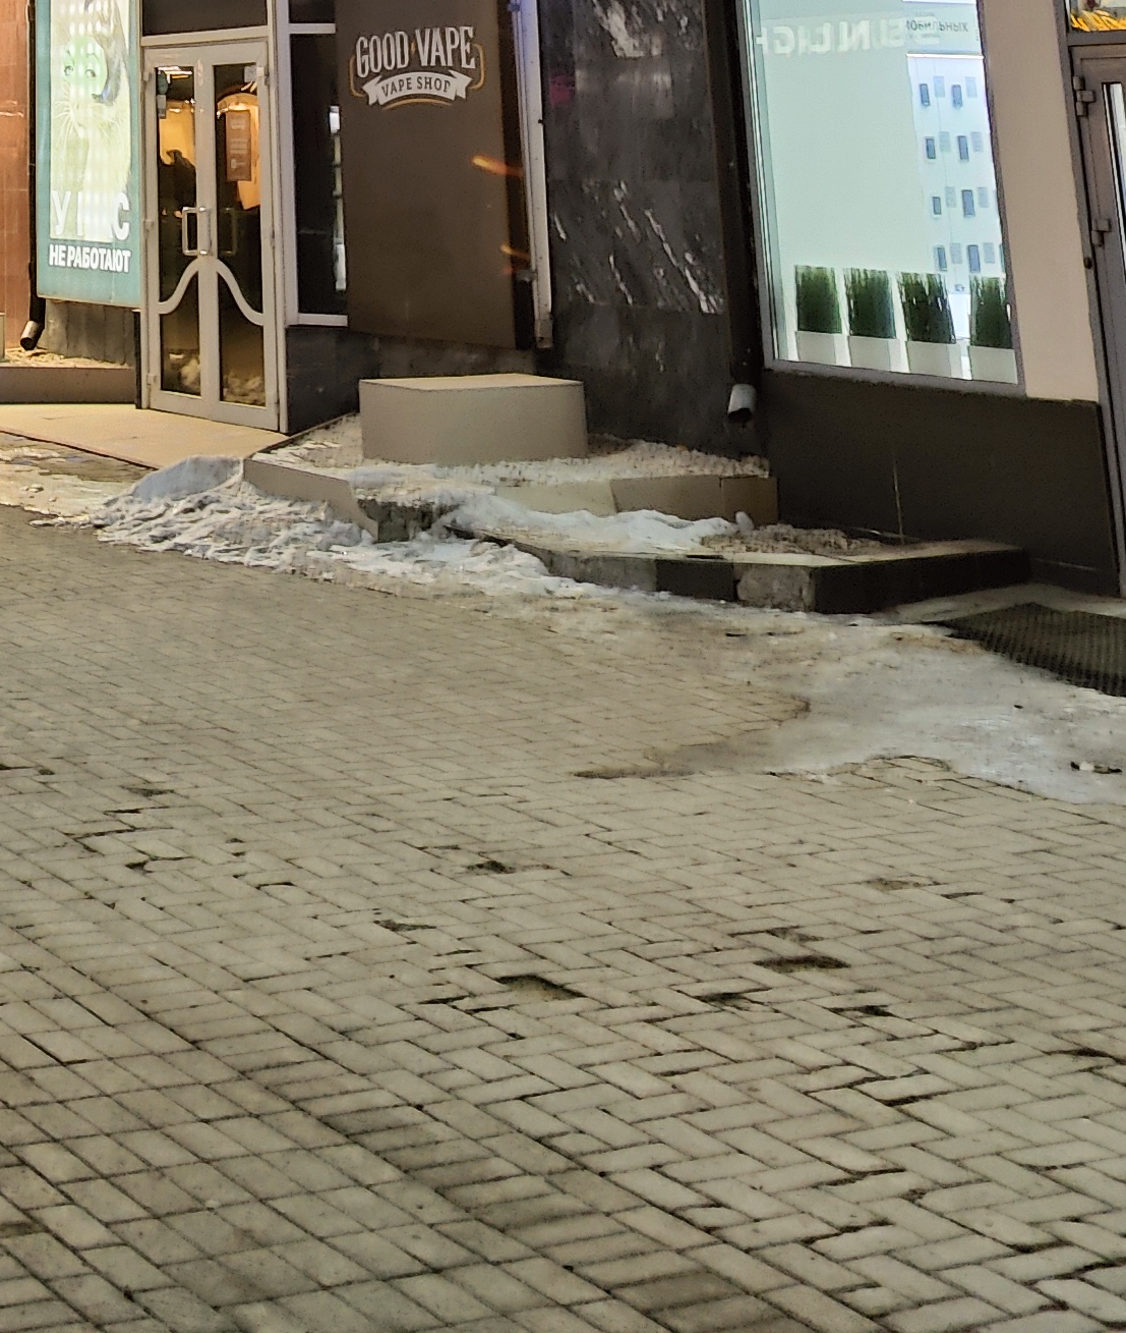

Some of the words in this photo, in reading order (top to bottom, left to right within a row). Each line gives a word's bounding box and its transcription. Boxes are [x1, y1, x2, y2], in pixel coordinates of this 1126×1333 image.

[355, 31, 409, 78] GOOD
[414, 26, 476, 69] VAPE
[381, 77, 413, 97] VAPE
[416, 76, 451, 93] SHOP
[48, 244, 67, 267] НЕ
[66, 245, 132, 274] РАБОТАЮТ
